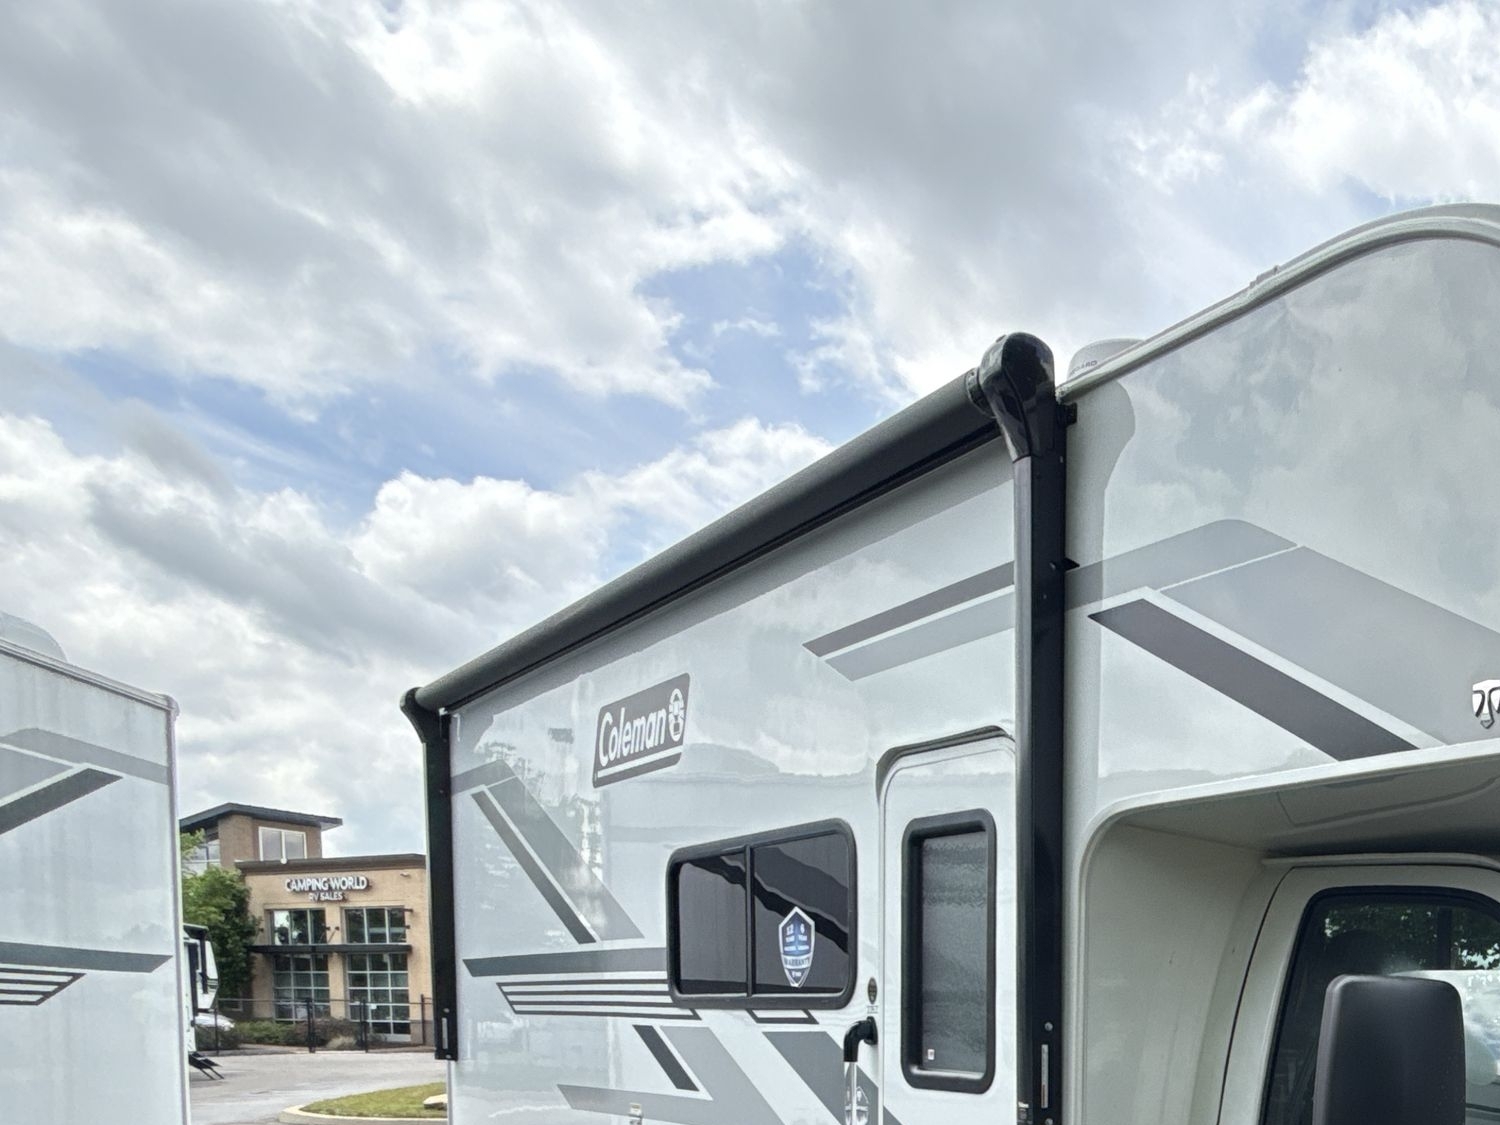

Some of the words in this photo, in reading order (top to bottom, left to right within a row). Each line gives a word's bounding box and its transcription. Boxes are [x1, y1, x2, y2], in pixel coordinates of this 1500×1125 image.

[600, 707, 667, 767] Coleman
[285, 877, 329, 892] CAMPING
[330, 875, 368, 890] WORLD
[308, 892, 319, 901] RV
[320, 891, 343, 901] SALES
